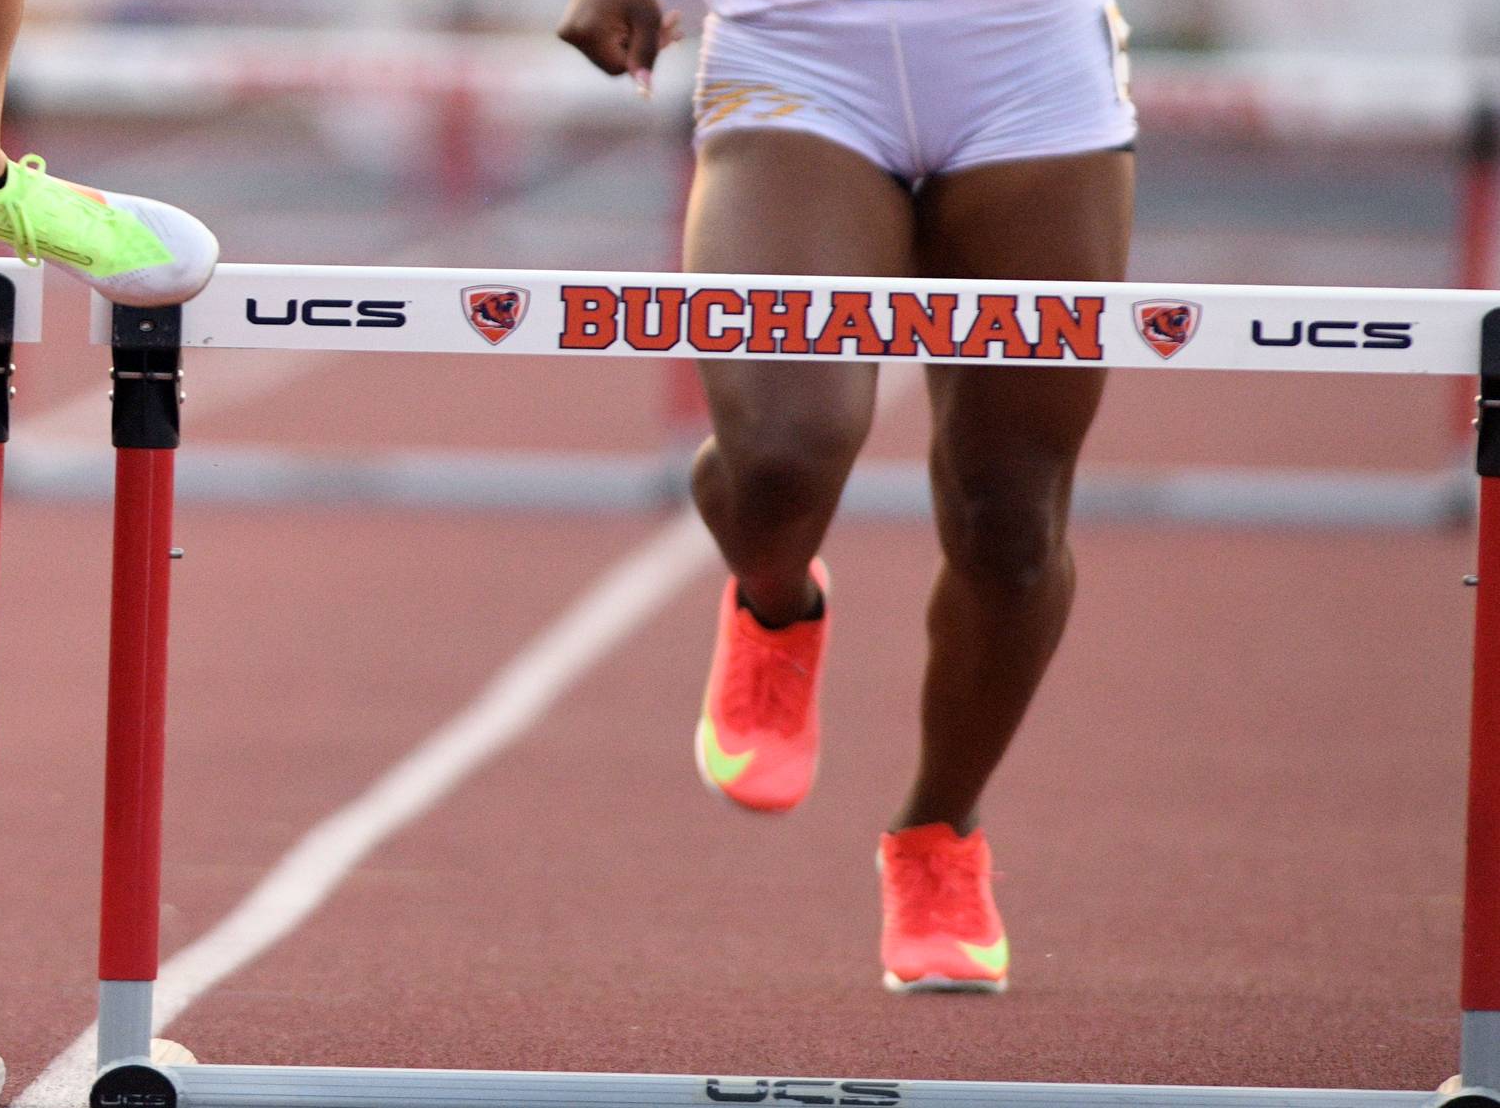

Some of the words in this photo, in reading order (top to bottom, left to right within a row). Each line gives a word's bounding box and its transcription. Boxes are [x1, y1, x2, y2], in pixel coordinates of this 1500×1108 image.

[246, 298, 405, 327] UCS
[558, 285, 1106, 360] BUCHANAN
[1251, 319, 1412, 349] UCS
[705, 1078, 899, 1106] UCS
